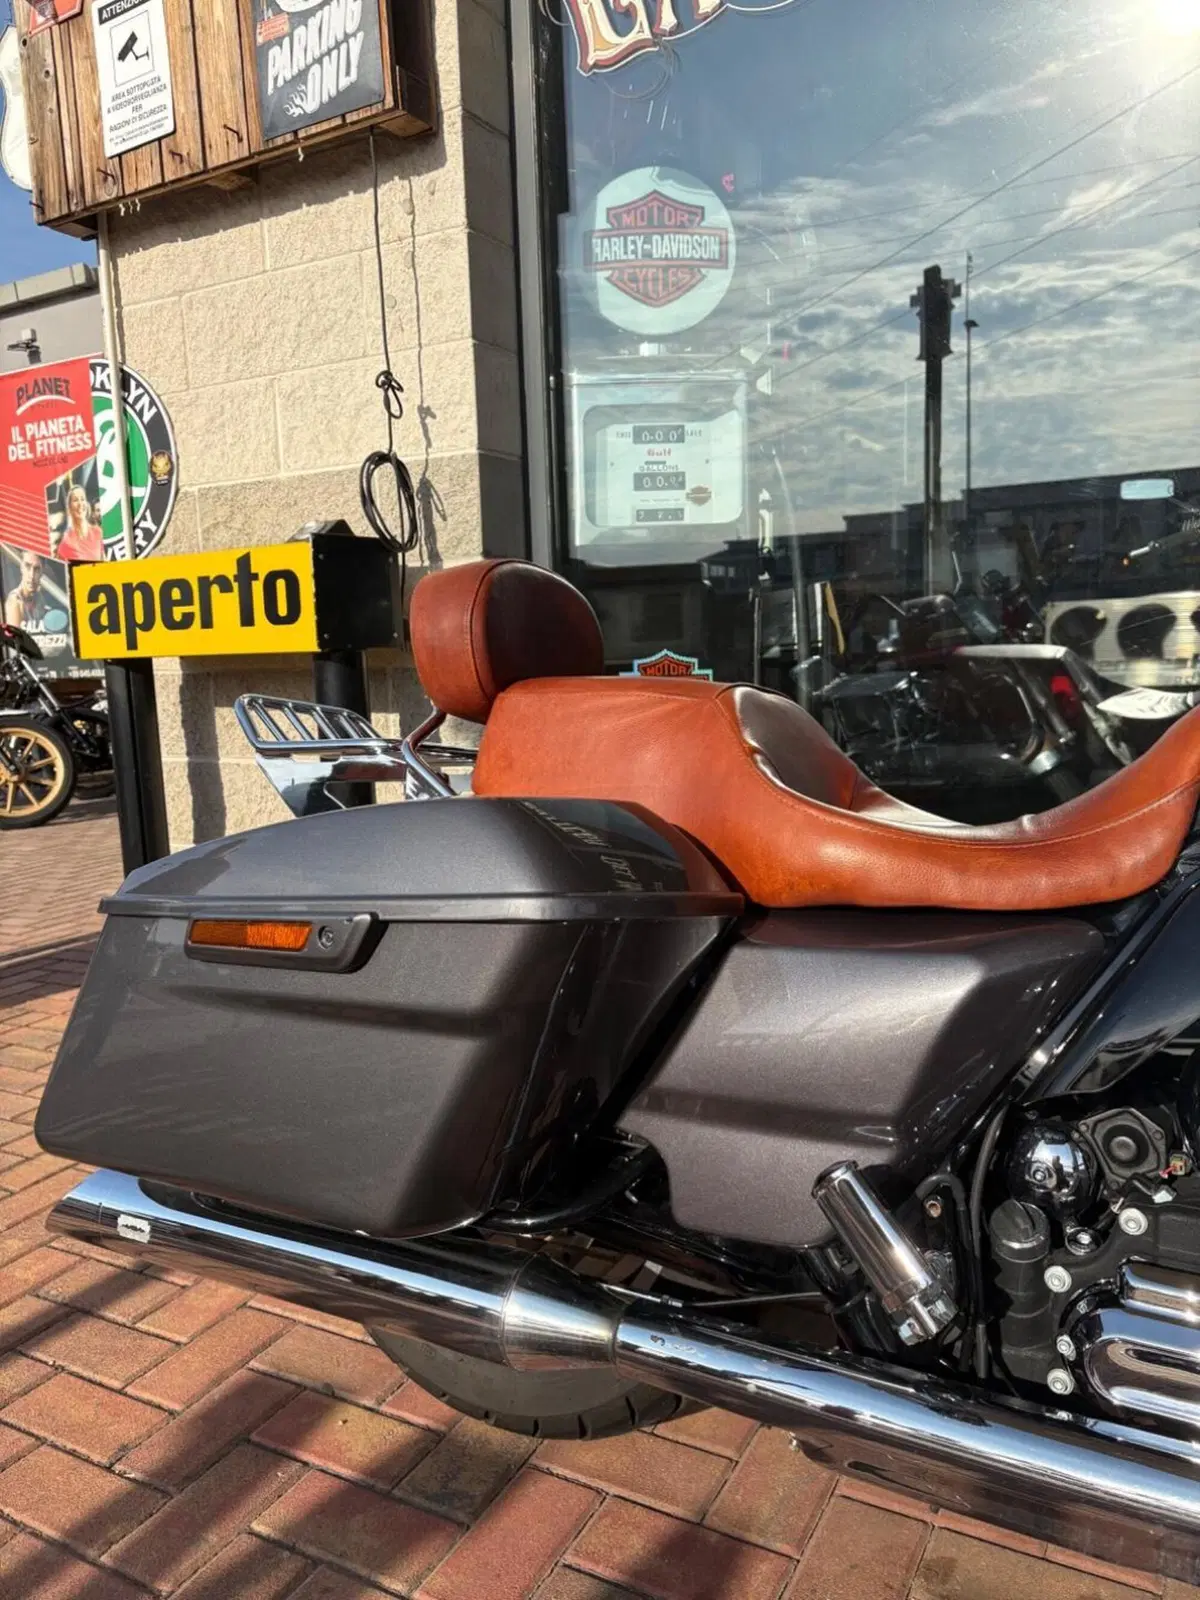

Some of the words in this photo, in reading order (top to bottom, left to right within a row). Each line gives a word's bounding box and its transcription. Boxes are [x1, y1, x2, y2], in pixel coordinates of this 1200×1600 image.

[102, 0, 142, 20] ATTENZI
[267, 0, 363, 96] PARKING
[306, 31, 364, 114] ONLY
[111, 91, 126, 102] AREA
[131, 104, 143, 114] PER
[622, 200, 689, 227] MOTOR
[592, 233, 720, 261] HARLEY-DAVIDSON
[623, 267, 696, 300] CYCLES
[16, 377, 70, 408] PLANET
[11, 426, 24, 444] IL
[25, 414, 86, 441] PIANETA
[8, 442, 34, 462] DEL
[35, 432, 93, 458] FITNESS
[87, 552, 302, 651] aperto
[646, 661, 688, 676] MOTOR
